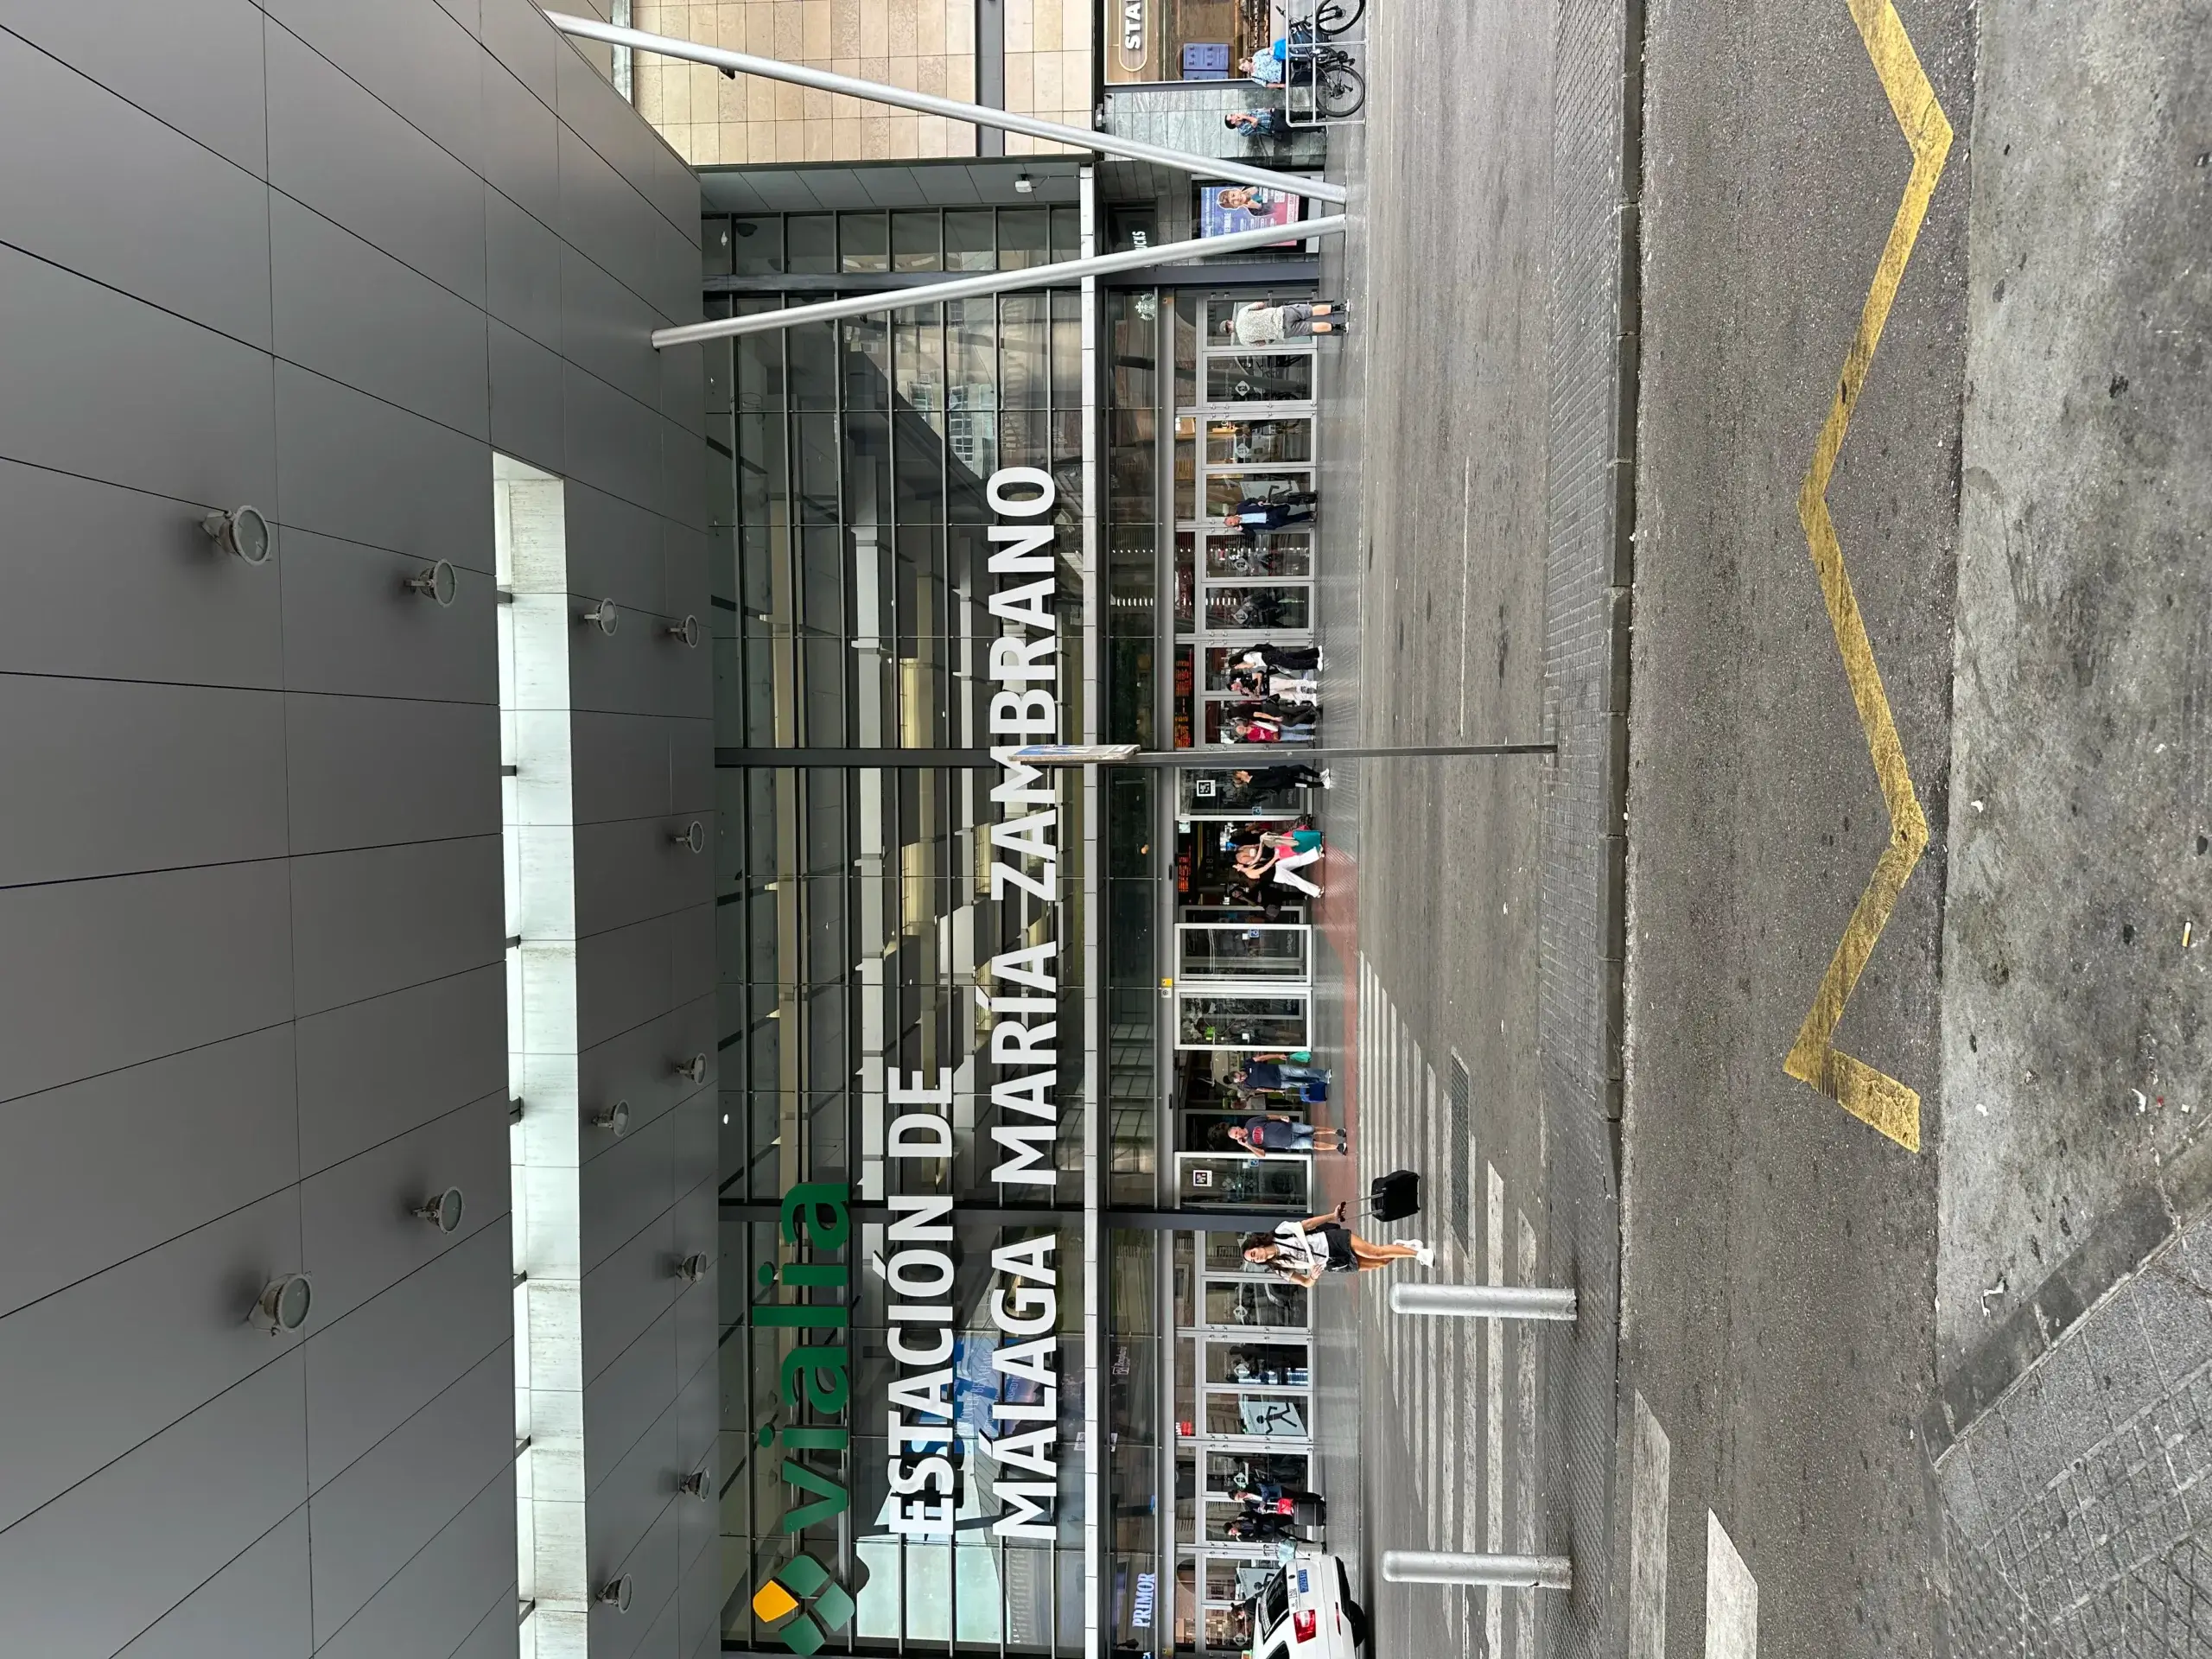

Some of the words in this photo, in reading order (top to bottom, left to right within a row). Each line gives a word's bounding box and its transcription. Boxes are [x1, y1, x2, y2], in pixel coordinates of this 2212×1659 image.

[1124, 0, 1141, 50] STA
[987, 467, 1057, 901] ZAMBRANO
[887, 1067, 954, 1158] DE
[976, 940, 1057, 1185] MARÍA
[752, 1182, 849, 1534] vialia
[872, 1194, 955, 1535] ESTACIÓN
[978, 1232, 1058, 1541] MÁLAGA
[1132, 1573, 1155, 1628] PRIMOR
